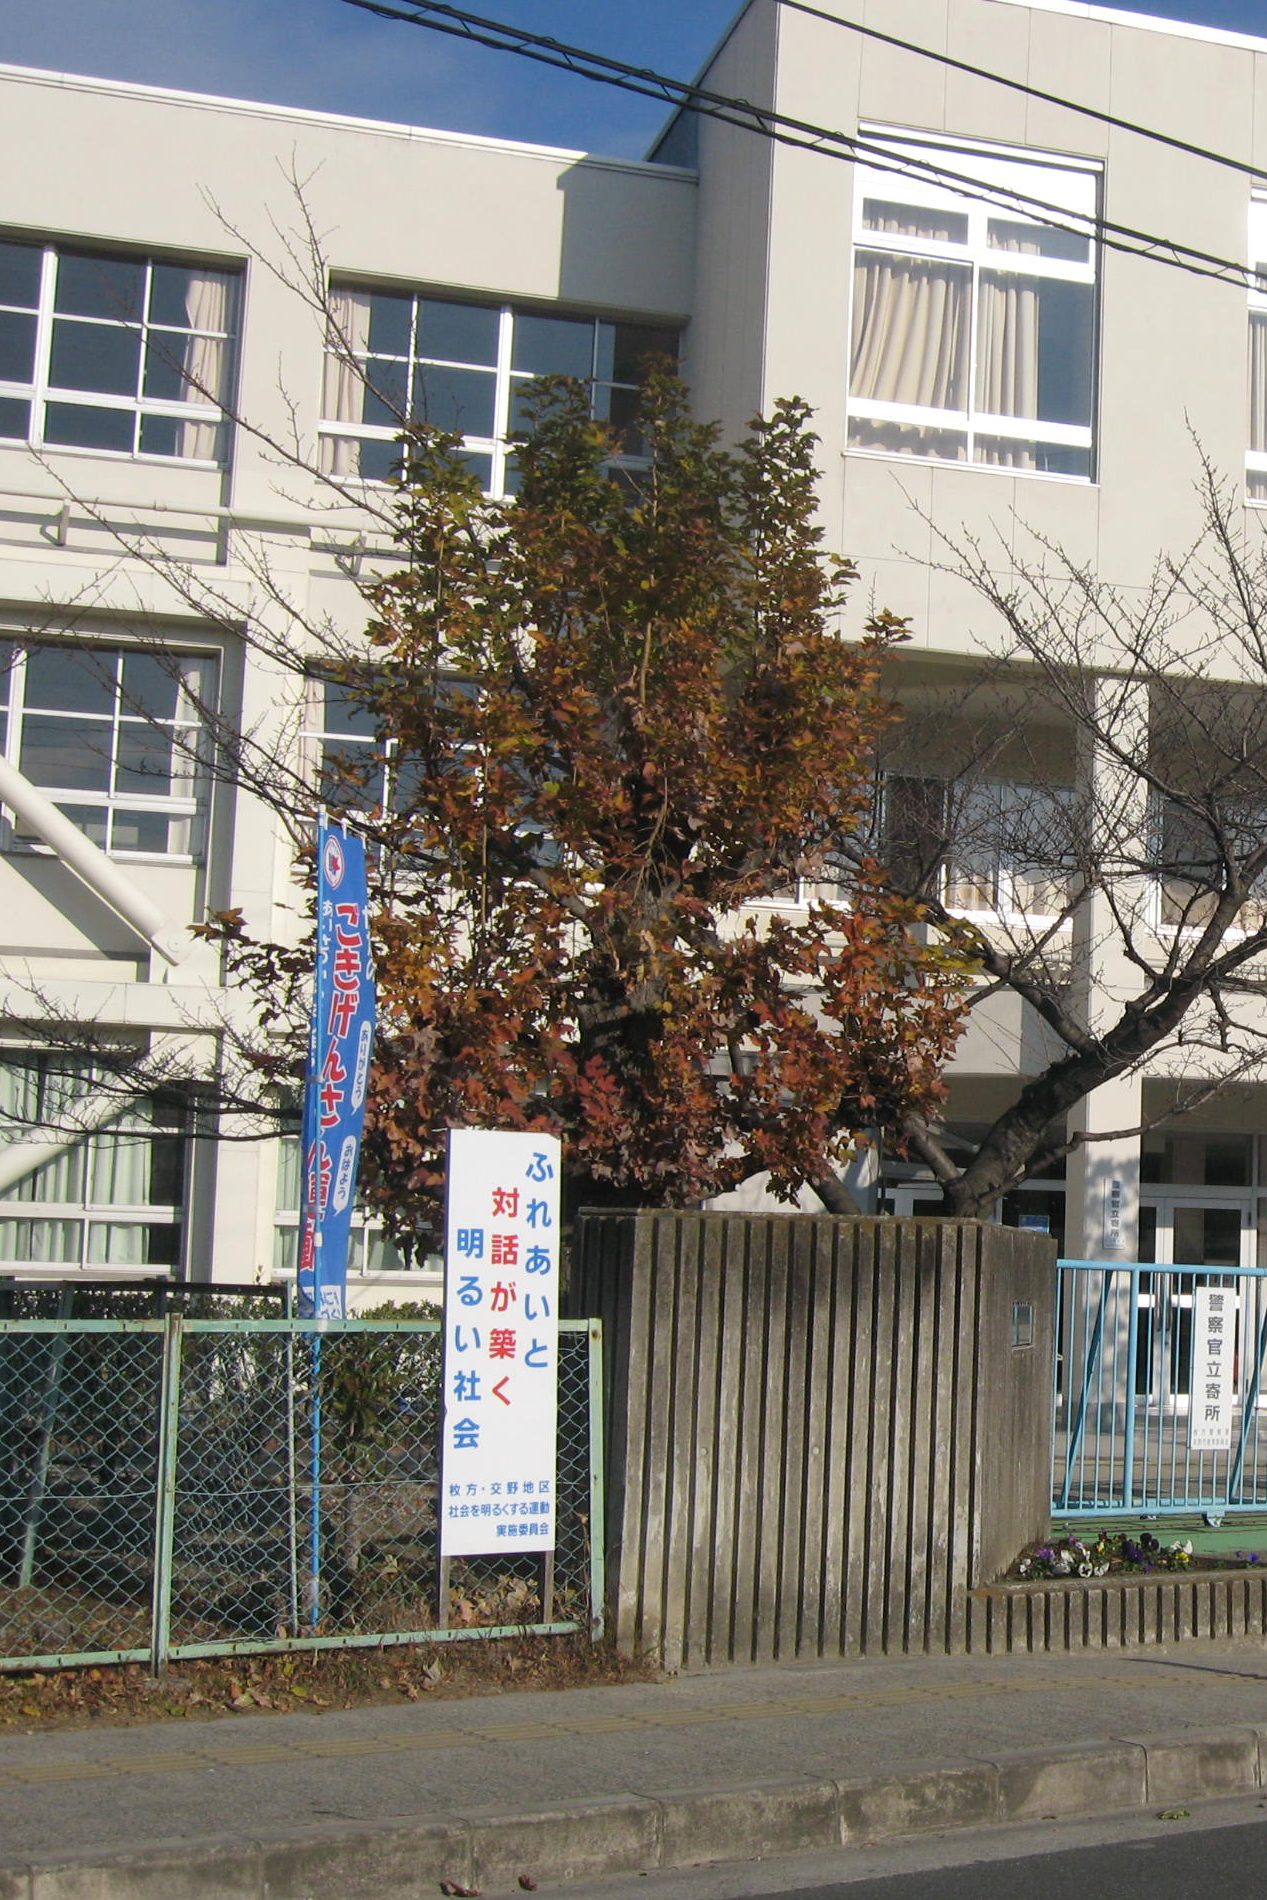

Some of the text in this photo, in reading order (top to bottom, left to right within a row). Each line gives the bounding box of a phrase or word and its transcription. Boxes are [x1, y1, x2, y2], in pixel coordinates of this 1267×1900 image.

[337, 1144, 353, 1200] おはよう
[488, 1186, 520, 1406] 対話が築く
[524, 1151, 554, 1369] ふれあいと
[452, 1228, 484, 1450] 明るい社会
[1204, 1294, 1225, 1422] 警察官立寄所
[448, 1501, 550, 1518] 社会を明るくする運動
[449, 1480, 550, 1496] 枚方・交野地区
[496, 1522, 549, 1537] 実施委員会
